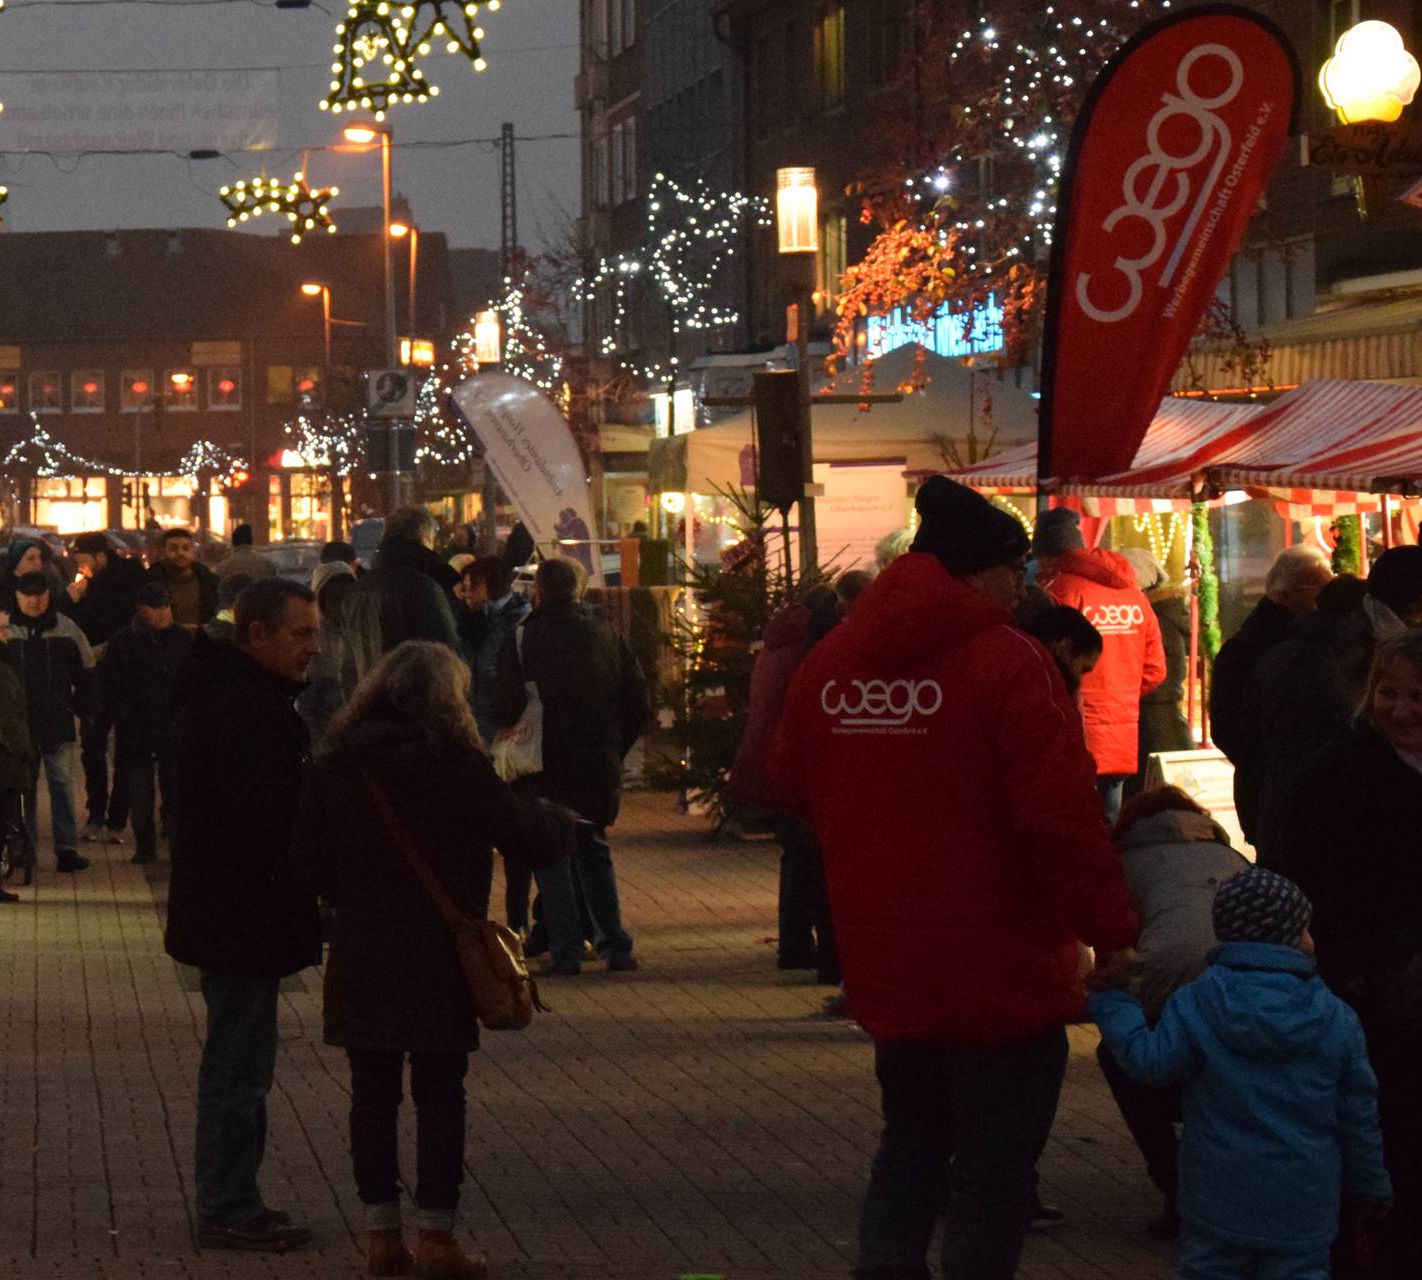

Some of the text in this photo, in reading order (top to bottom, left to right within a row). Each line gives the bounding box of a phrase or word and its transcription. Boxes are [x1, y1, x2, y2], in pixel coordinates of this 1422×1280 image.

[1076, 42, 1244, 323] wego
[1161, 188, 1234, 319] Werbegemeinschaft
[1225, 126, 1264, 188] Osterfeld
[1082, 605, 1144, 629] wego
[821, 678, 943, 725] wego
